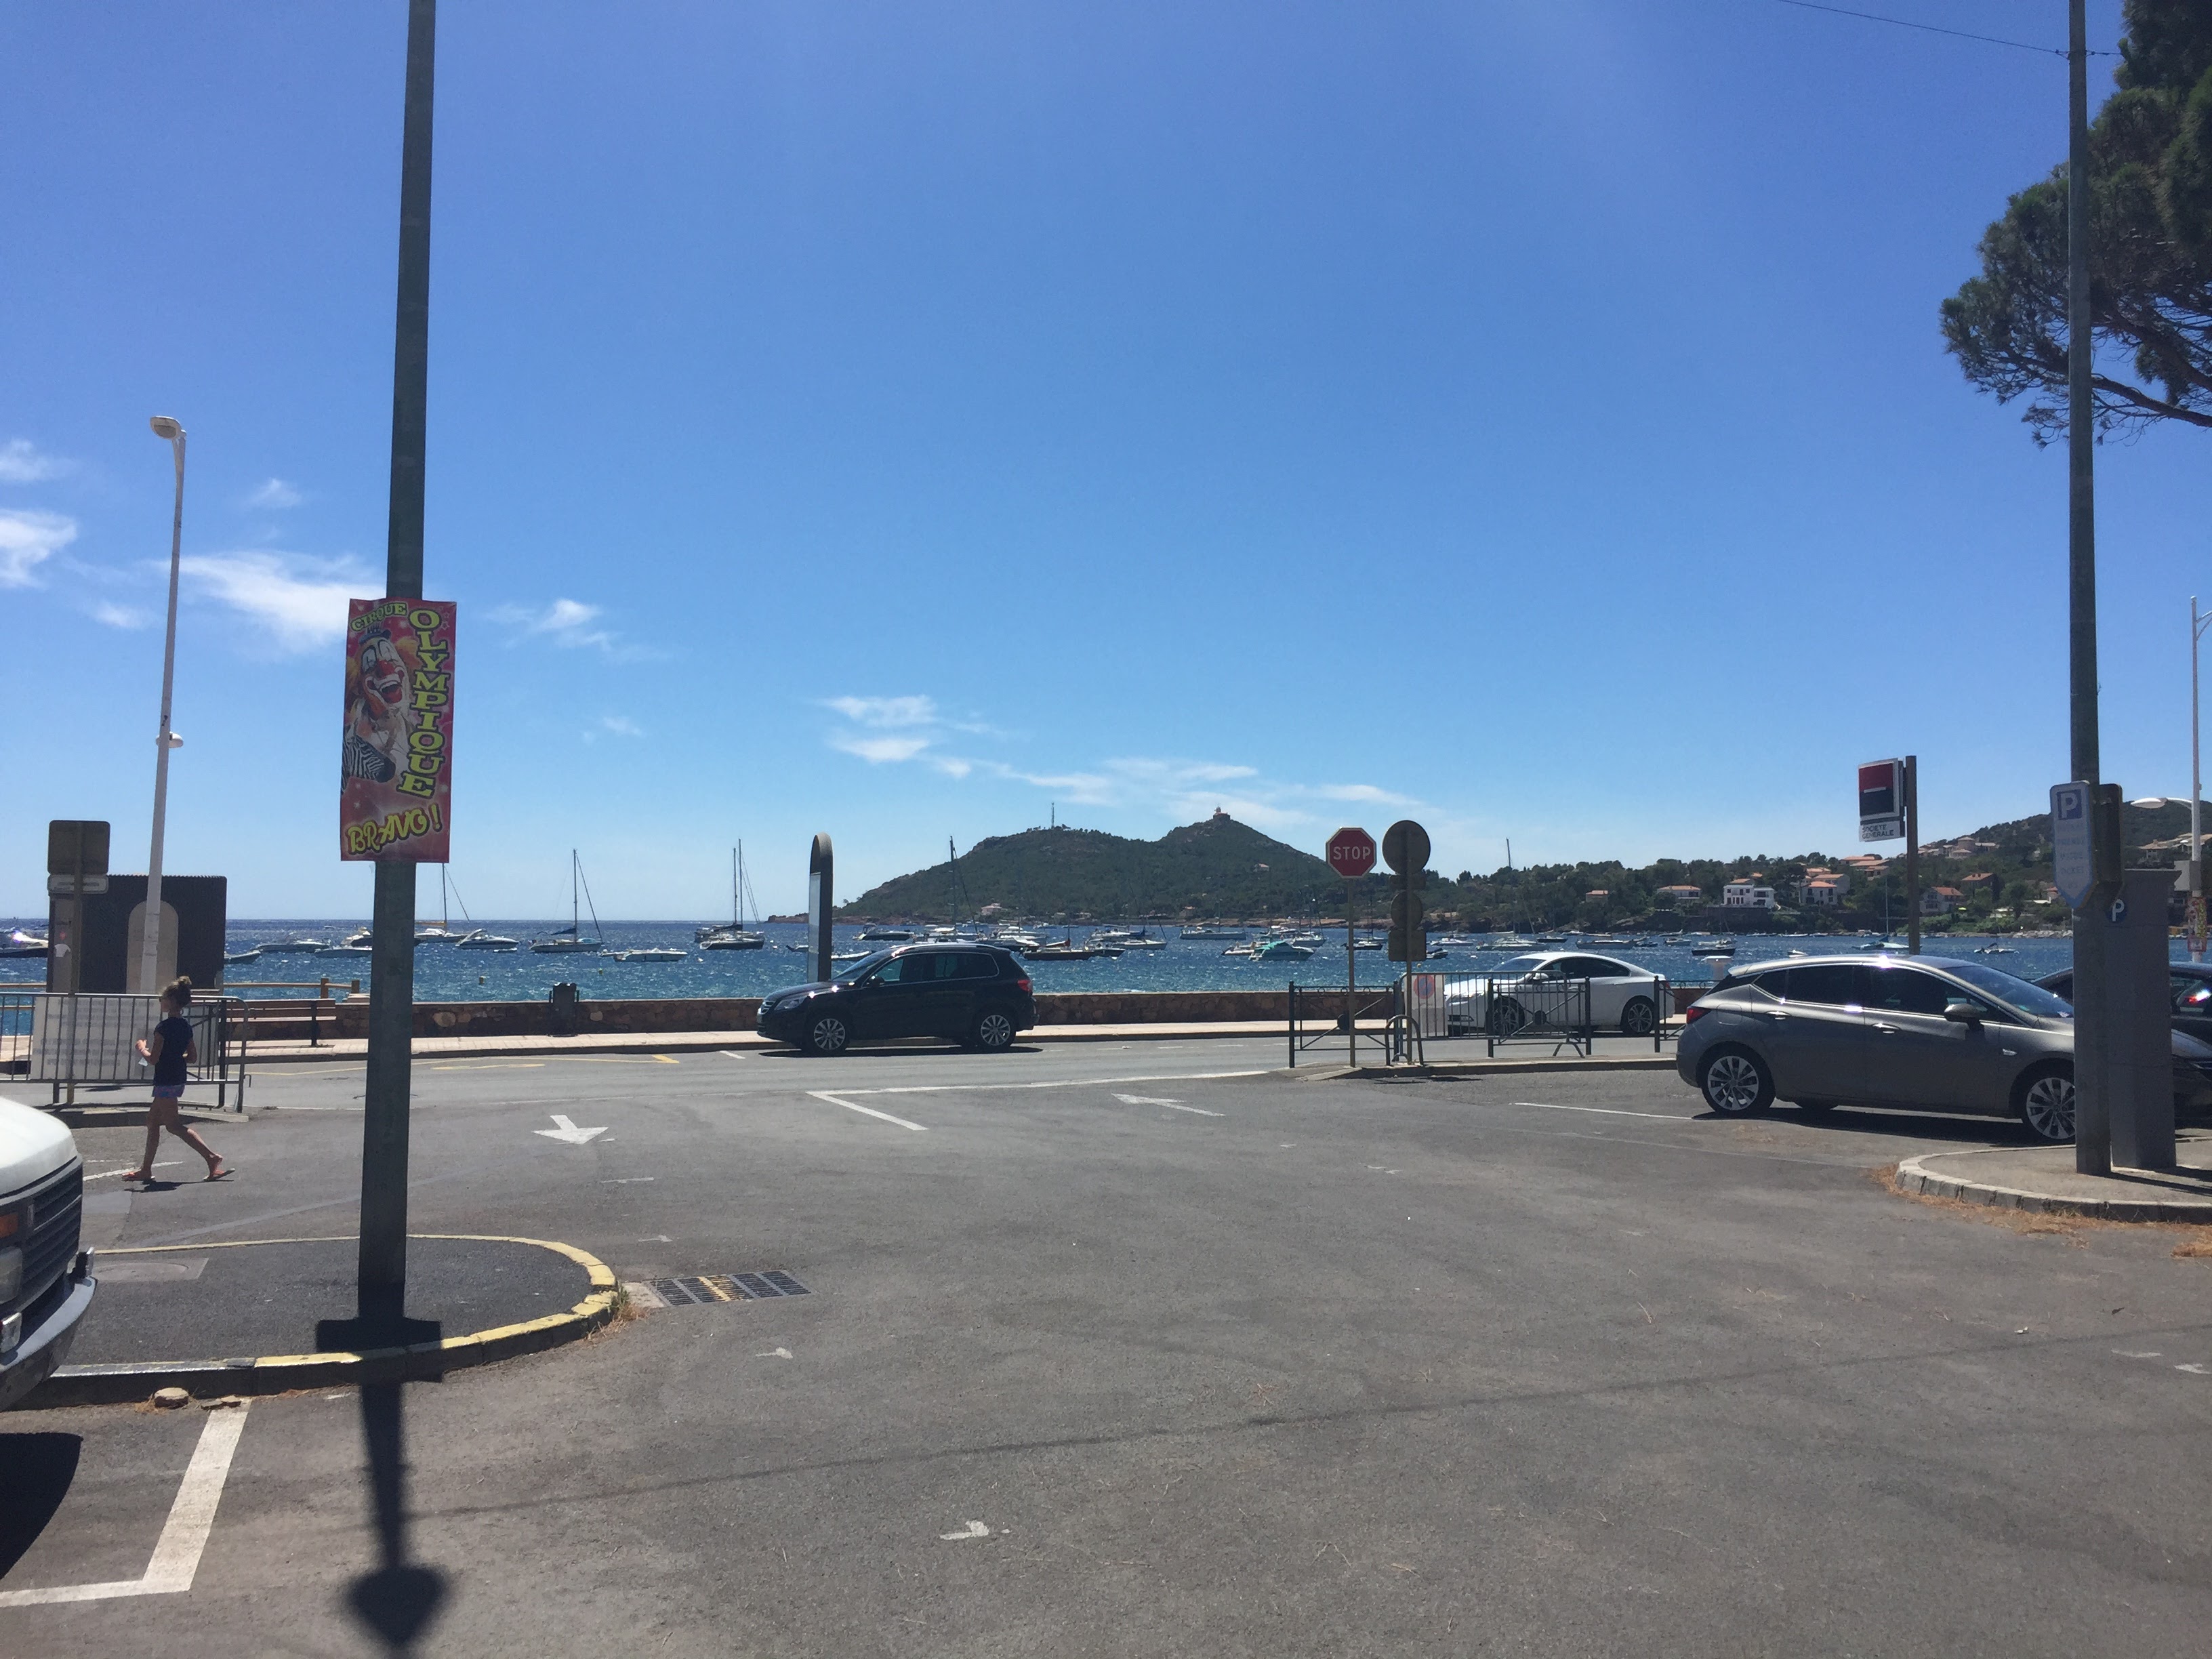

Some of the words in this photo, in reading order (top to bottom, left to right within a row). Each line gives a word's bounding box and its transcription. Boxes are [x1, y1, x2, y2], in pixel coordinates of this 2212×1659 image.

[350, 602, 407, 632] CIRQUE
[396, 608, 449, 799] OLYMPIQUE
[2060, 792, 2078, 818] P
[1862, 830, 1894, 839] GENERALE
[1333, 846, 1371, 860] STOP
[2112, 899, 2125, 922] P
